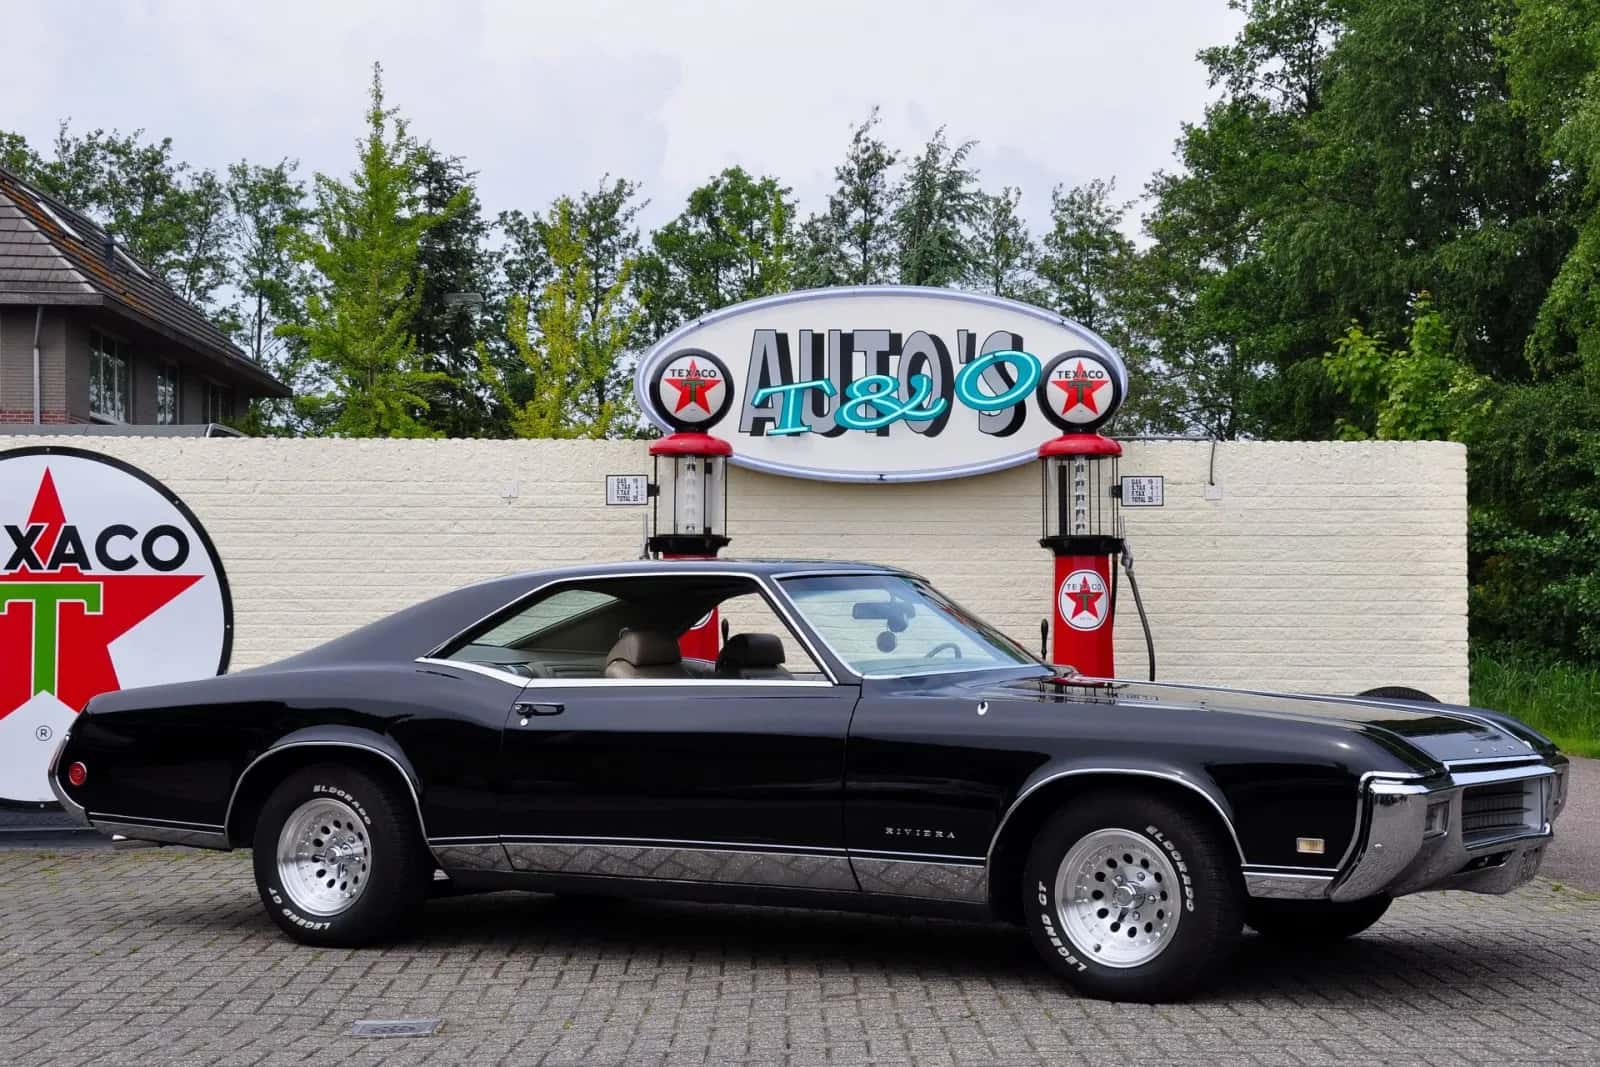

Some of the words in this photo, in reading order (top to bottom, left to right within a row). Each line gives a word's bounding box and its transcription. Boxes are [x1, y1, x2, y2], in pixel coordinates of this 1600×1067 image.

[669, 368, 717, 378] TEXACO
[739, 329, 1026, 437] AUTO'S
[1056, 370, 1104, 379] TEXACO
[682, 380, 705, 402] T
[1068, 381, 1093, 403] T
[3, 523, 191, 573] XACO
[1066, 583, 1103, 591] TEXACO
[313, 784, 372, 825] ELDORADO
[885, 827, 956, 839] RIVIERA
[1145, 825, 1195, 912] ELDORADO
[268, 887, 283, 904] GT
[1038, 880, 1048, 906] GT
[282, 908, 331, 931] LEGEND
[1041, 913, 1088, 972] LEGEND
